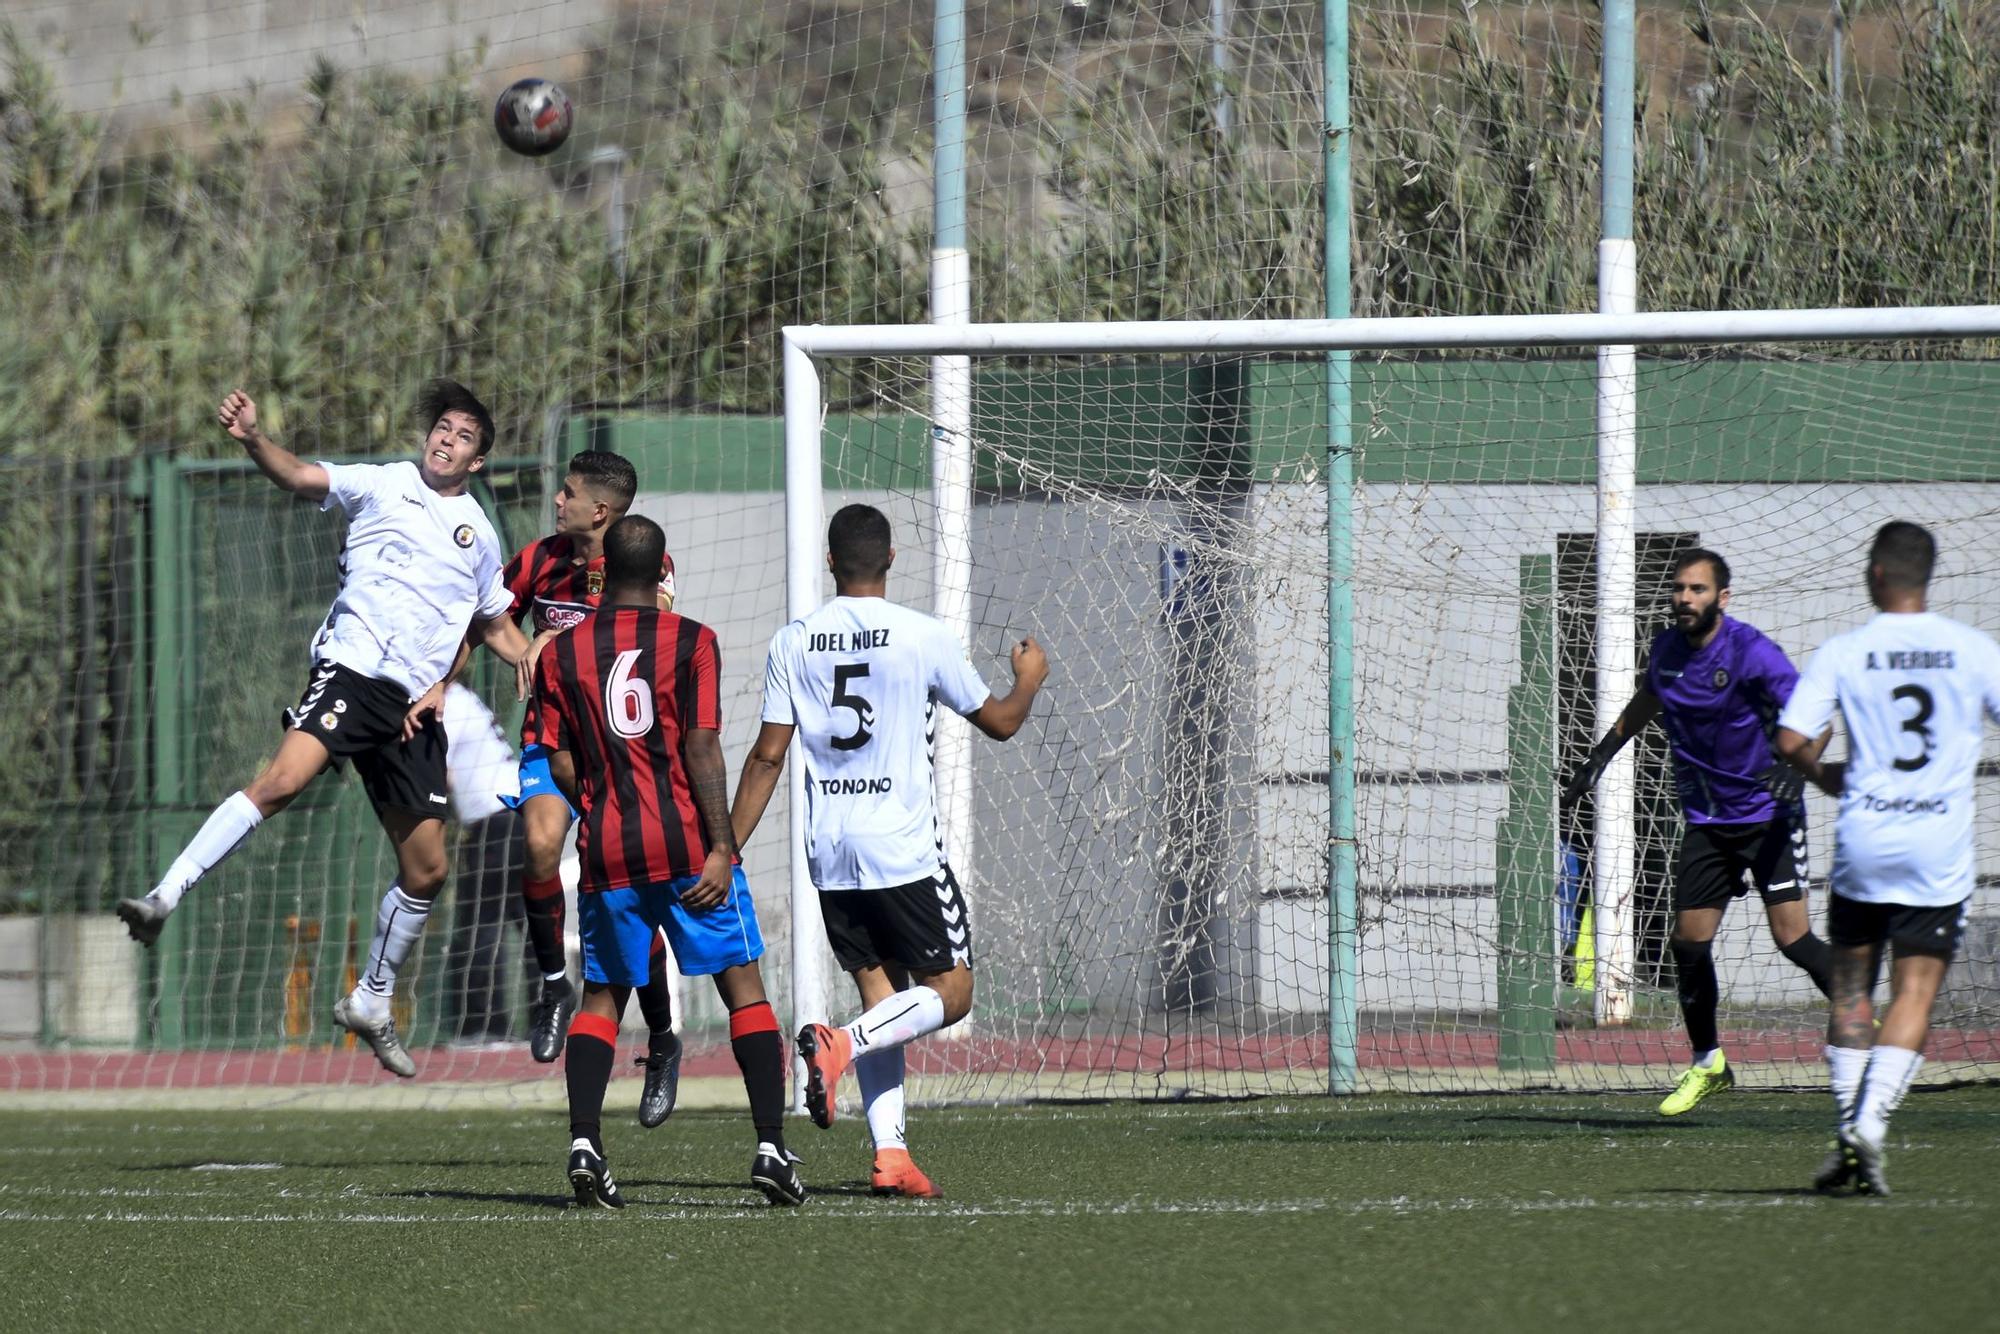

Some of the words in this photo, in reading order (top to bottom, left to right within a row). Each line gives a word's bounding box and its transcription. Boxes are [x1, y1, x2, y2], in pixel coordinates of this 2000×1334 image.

[808, 633, 846, 652] JOEL
[852, 629, 889, 651] NUEZ
[1866, 651, 1882, 670] A.
[1886, 651, 1956, 669] VERDES
[606, 649, 654, 738] 6
[333, 699, 347, 713] 9
[831, 663, 875, 751] 5
[1891, 684, 1936, 772] 3
[819, 777, 892, 795] TONONO
